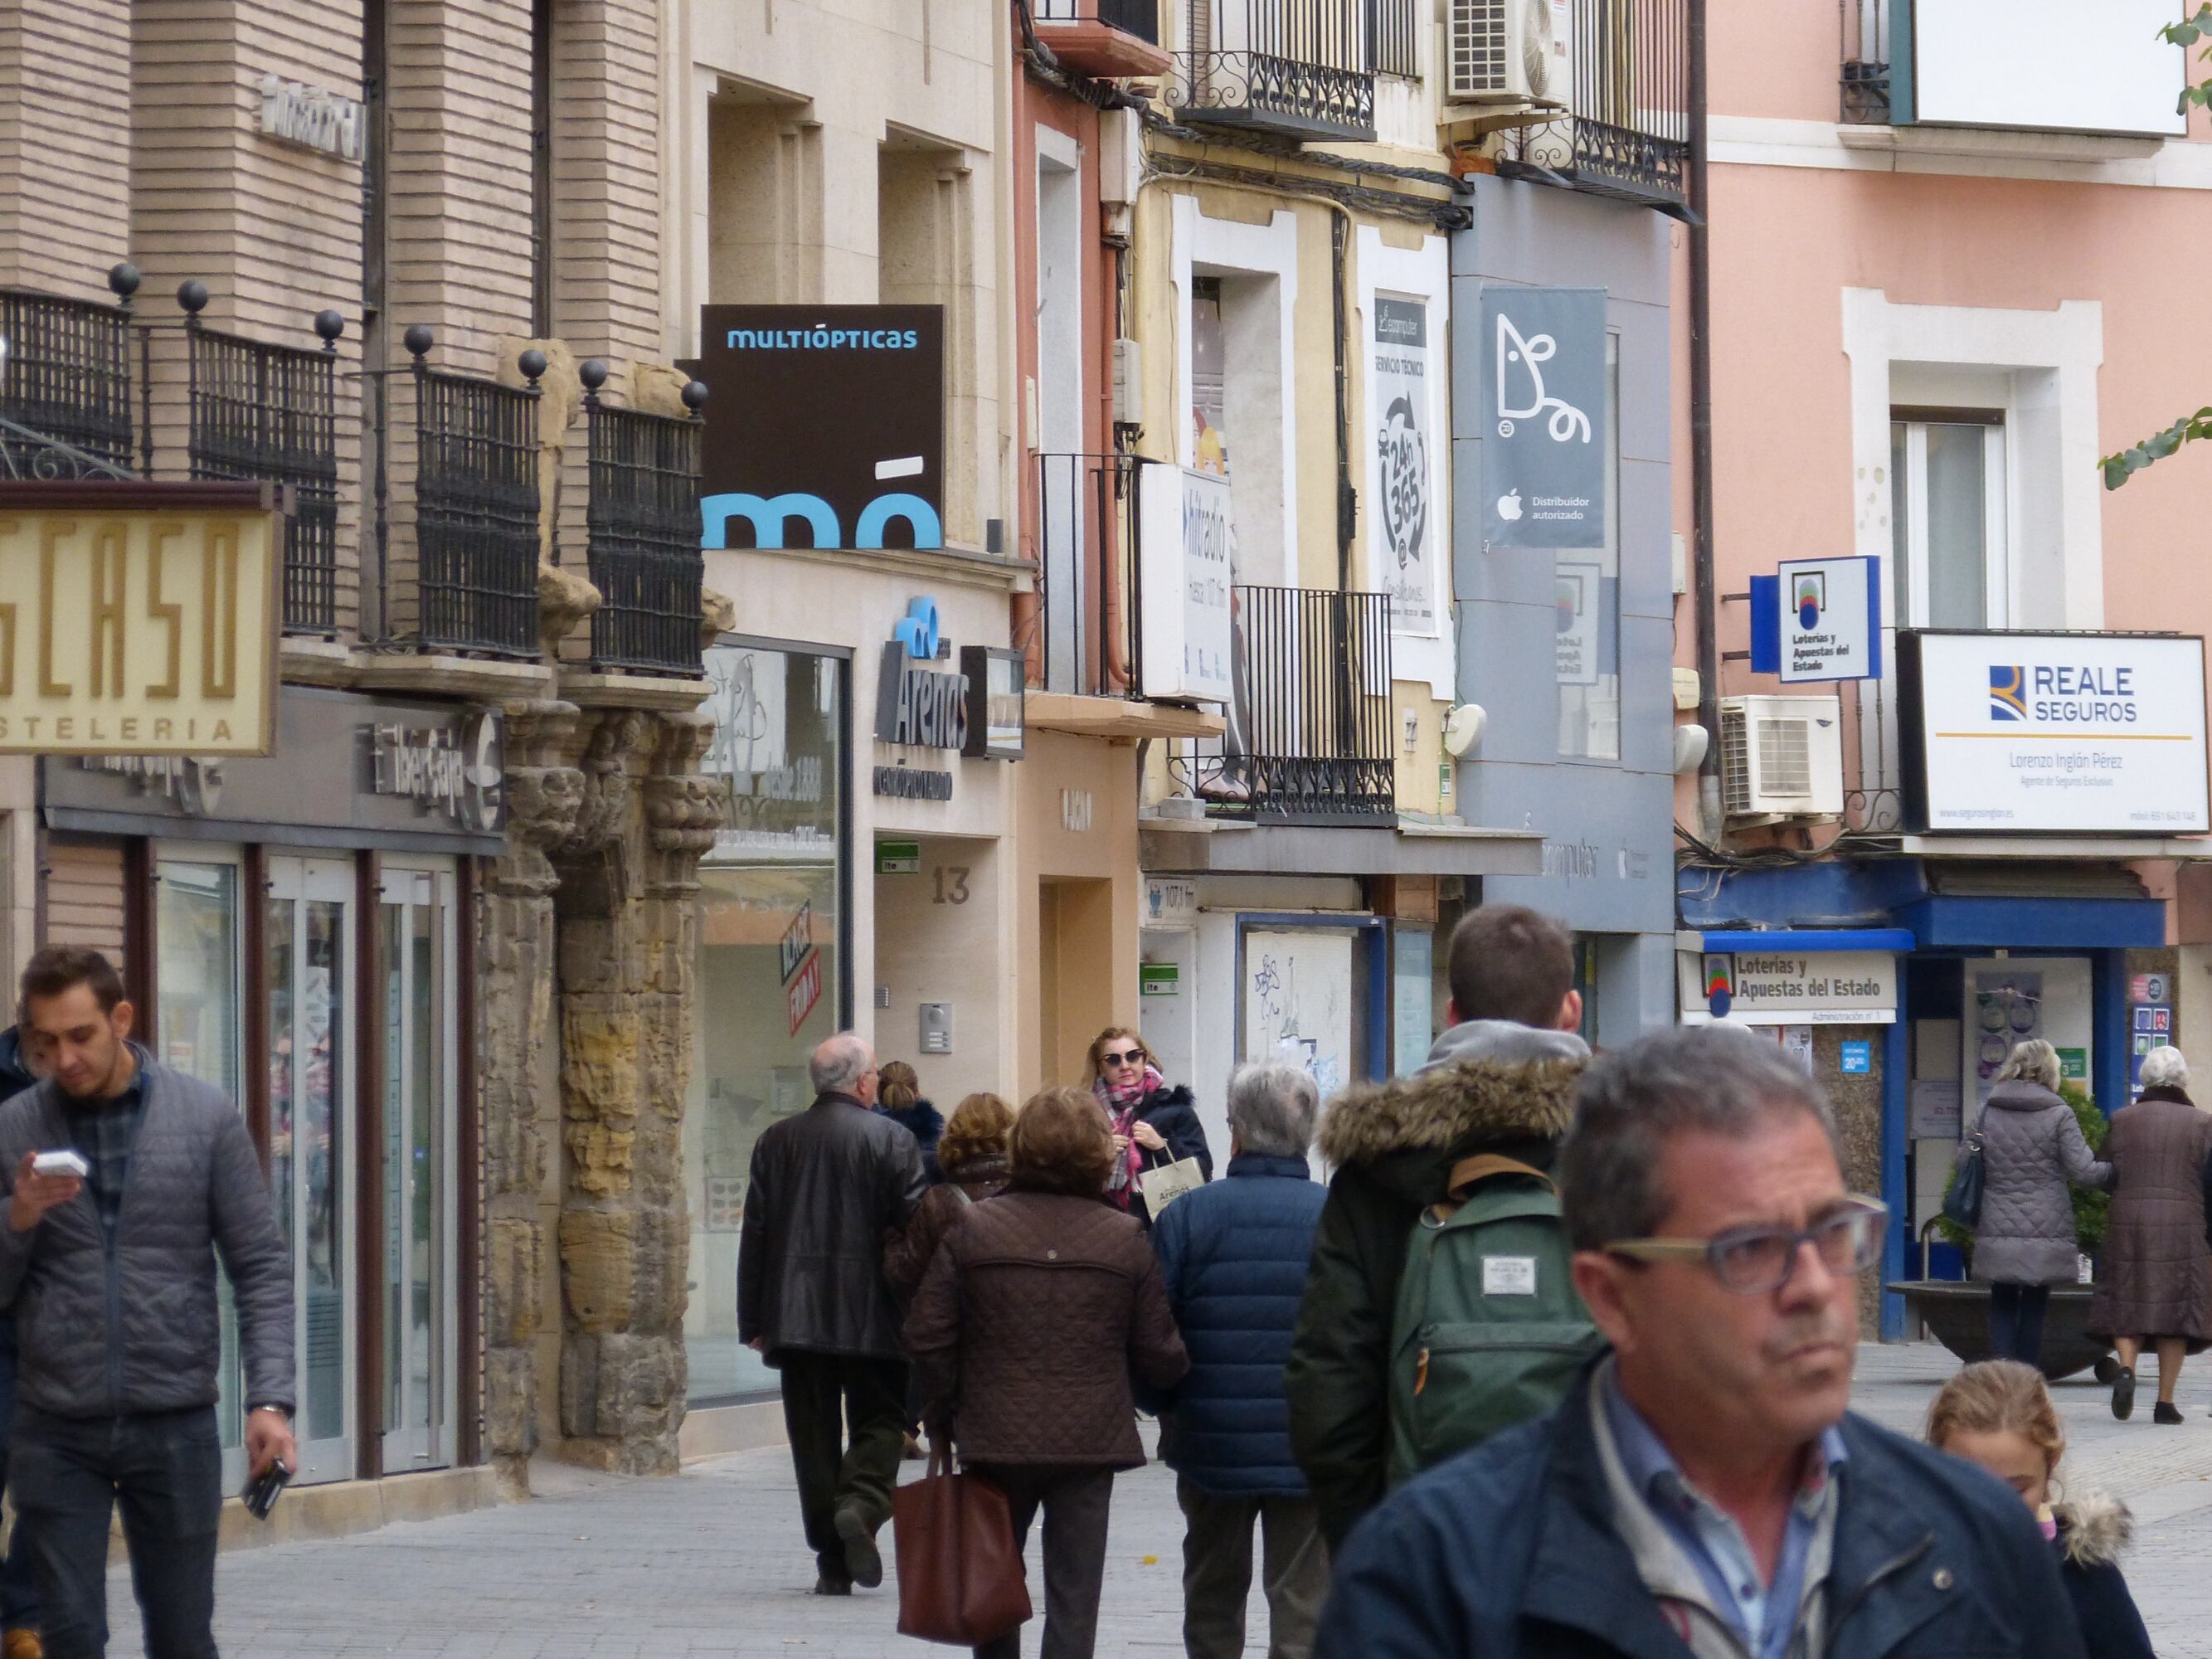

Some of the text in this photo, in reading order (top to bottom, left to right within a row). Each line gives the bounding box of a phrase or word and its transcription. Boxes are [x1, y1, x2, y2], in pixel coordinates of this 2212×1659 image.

[1391, 467, 1419, 535] 365
[1533, 497, 1589, 507] Distribuidor
[1532, 511, 1584, 520] autorizado
[1793, 634, 1836, 645] Loterías y
[1793, 645, 1850, 660] Apuestas del
[1792, 660, 1823, 672] Estado
[2035, 666, 2135, 696] REALE
[2035, 701, 2137, 722] SEGUROS
[2010, 752, 2054, 768] Lorenzo
[2093, 752, 2123, 769] Pérez
[932, 865, 970, 905] 13
[1737, 956, 1807, 978] Loterías y
[1740, 978, 1881, 1002] Apuestas del Estado
